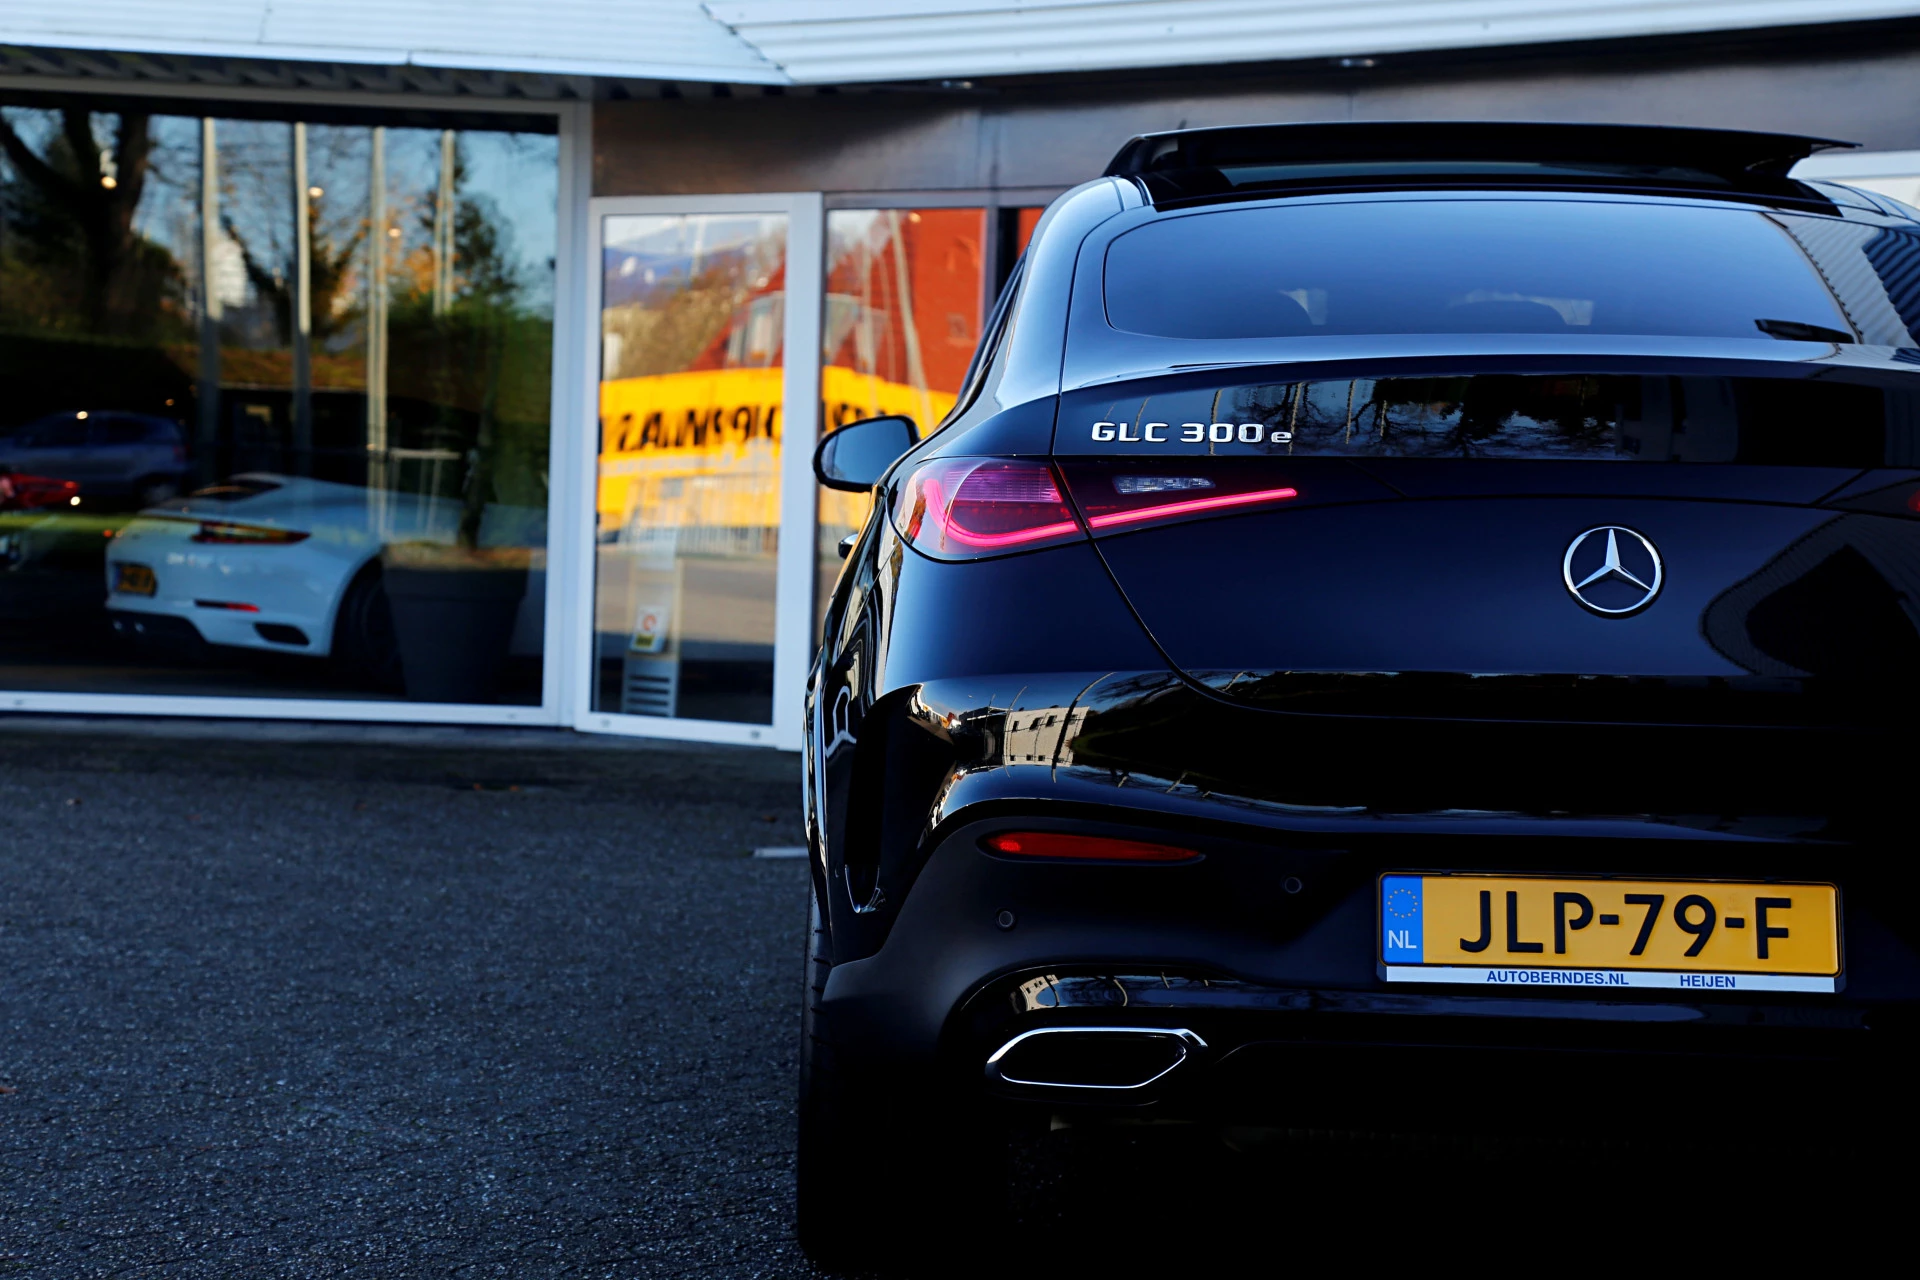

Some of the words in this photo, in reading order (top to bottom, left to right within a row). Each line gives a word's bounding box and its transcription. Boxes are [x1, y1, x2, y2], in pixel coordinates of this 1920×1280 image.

[1091, 422, 1169, 443] GLC
[1459, 890, 1792, 960] JLP-79-F
[1388, 930, 1417, 949] NL
[1486, 970, 1630, 986] AUTOBERNDES.NL
[1679, 974, 1736, 988] HEIJEN
